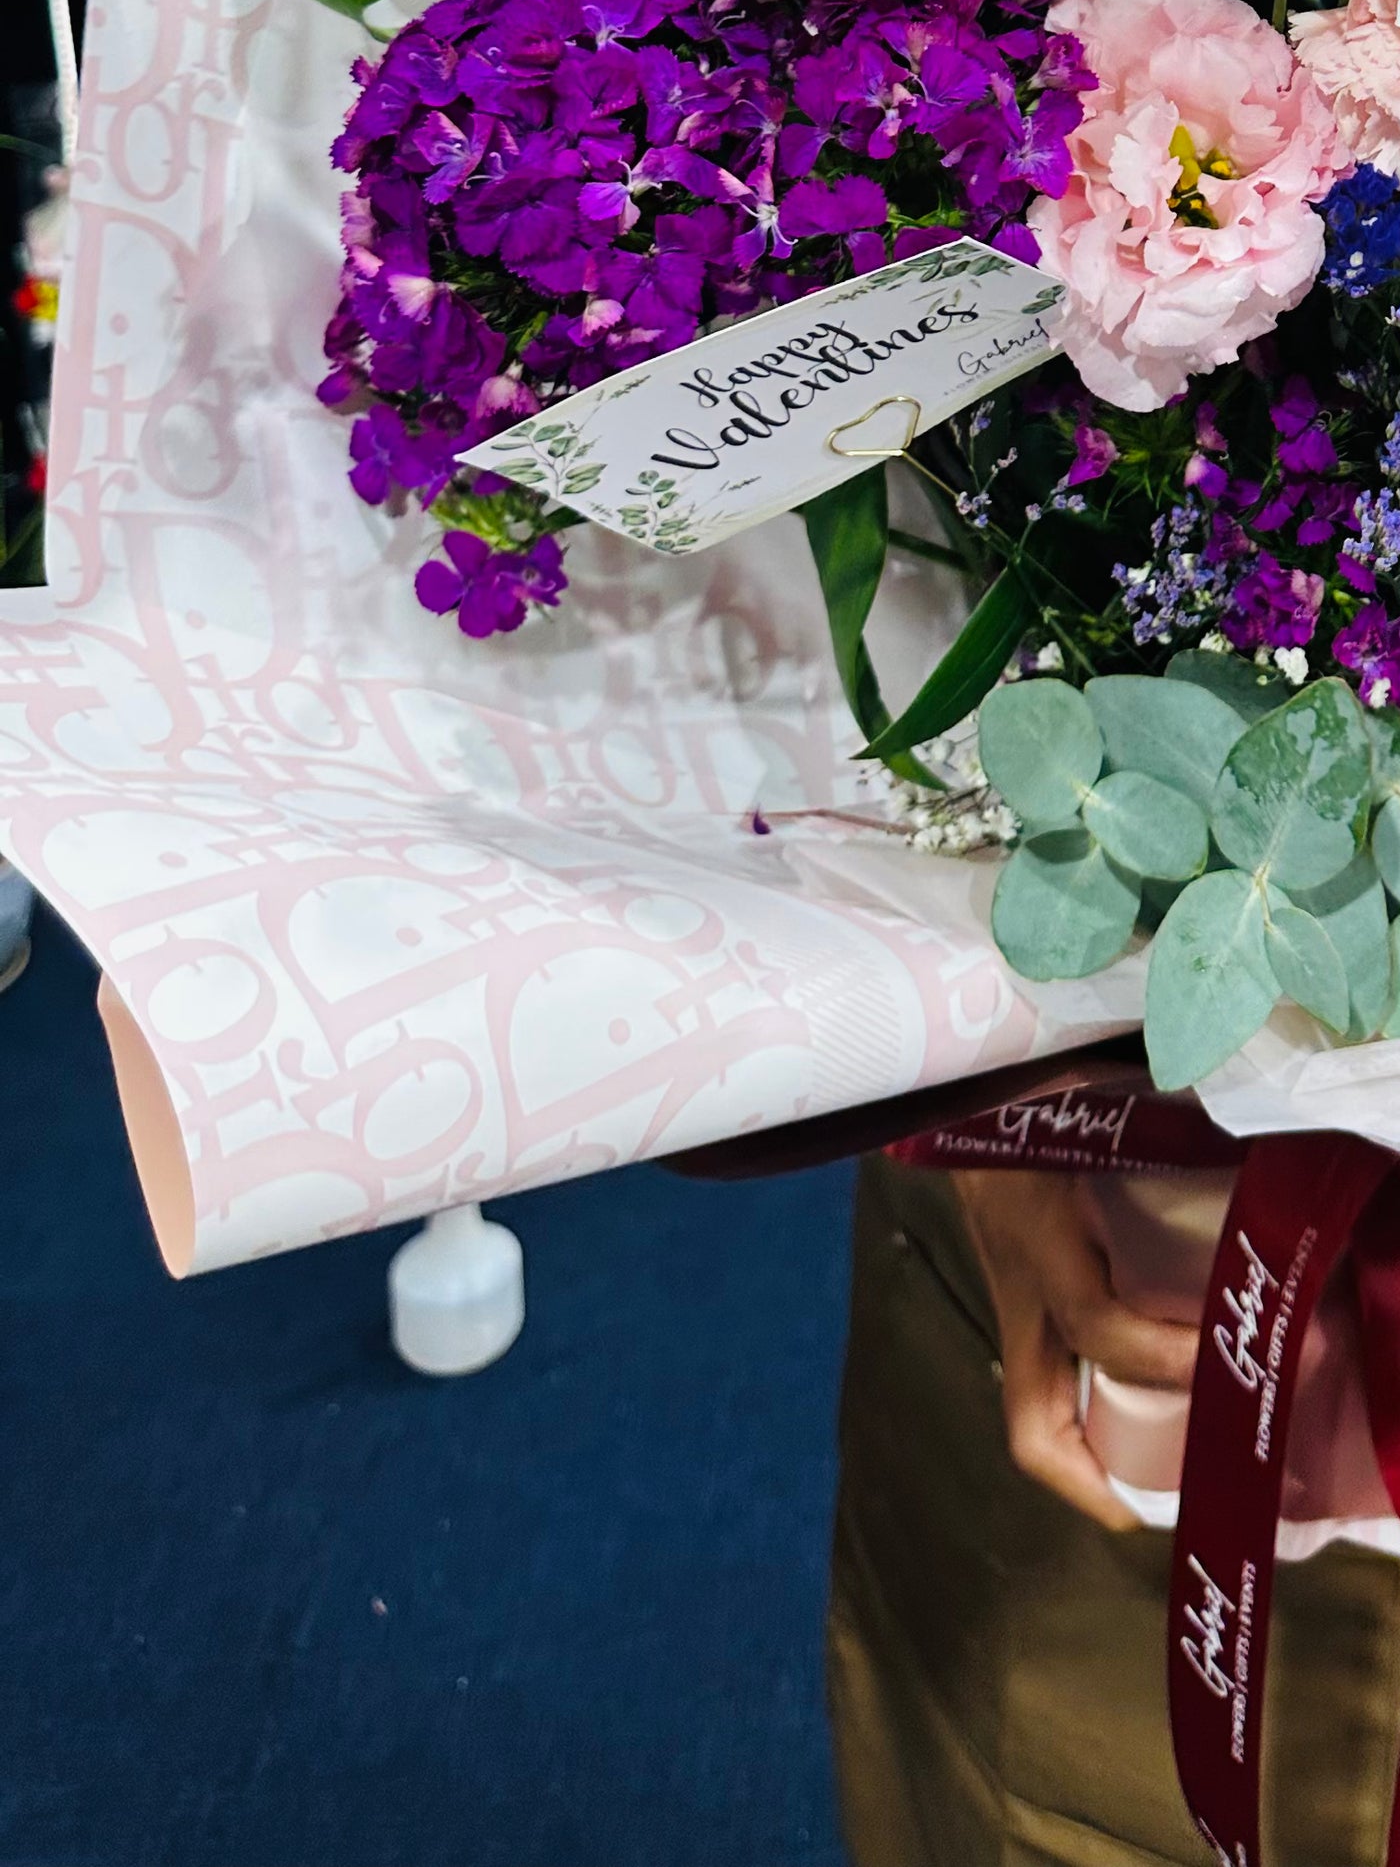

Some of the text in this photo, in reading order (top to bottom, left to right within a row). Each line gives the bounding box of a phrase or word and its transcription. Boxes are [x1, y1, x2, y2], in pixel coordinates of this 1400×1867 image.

[651, 302, 979, 470] Valentines
[679, 320, 858, 408] Happy
[998, 1090, 1136, 1152] Gabriel
[1212, 1230, 1280, 1392] Gabriel
[1180, 1553, 1237, 1698] Gabriel
